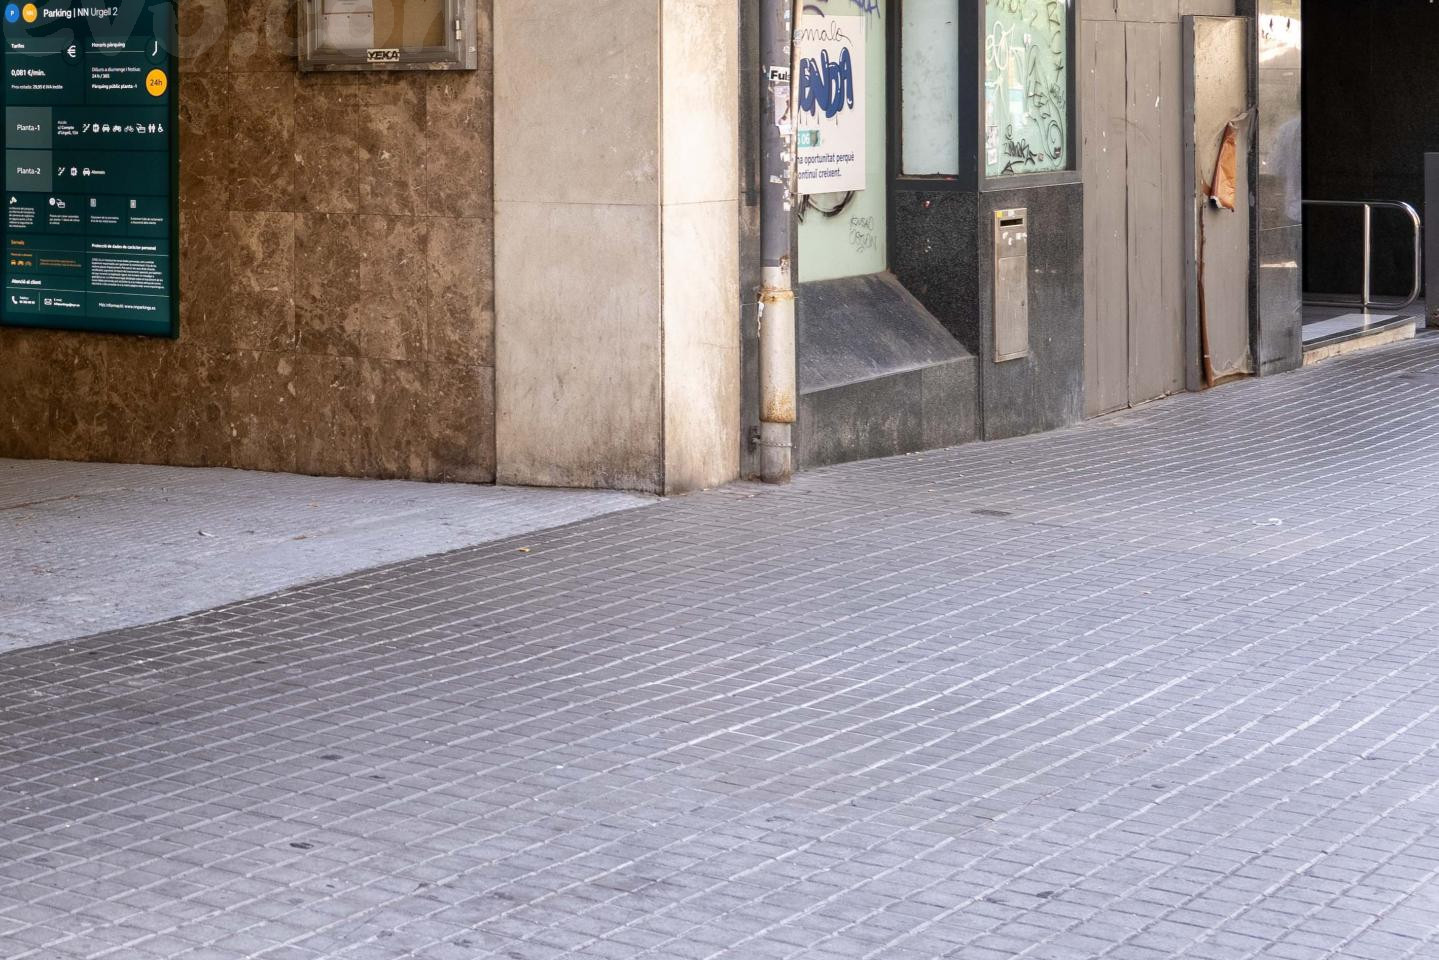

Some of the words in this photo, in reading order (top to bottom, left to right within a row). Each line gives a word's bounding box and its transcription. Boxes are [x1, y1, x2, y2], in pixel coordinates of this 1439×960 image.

[43, 8, 72, 19] Parking
[77, 8, 89, 17] NN
[90, 7, 112, 18] Urgell
[112, 7, 118, 16] 2
[368, 51, 399, 60] YEKA
[150, 79, 163, 87] 24h
[804, 153, 836, 166] oportunitat
[17, 167, 35, 175] Planta
[798, 168, 818, 180] ontinuï
